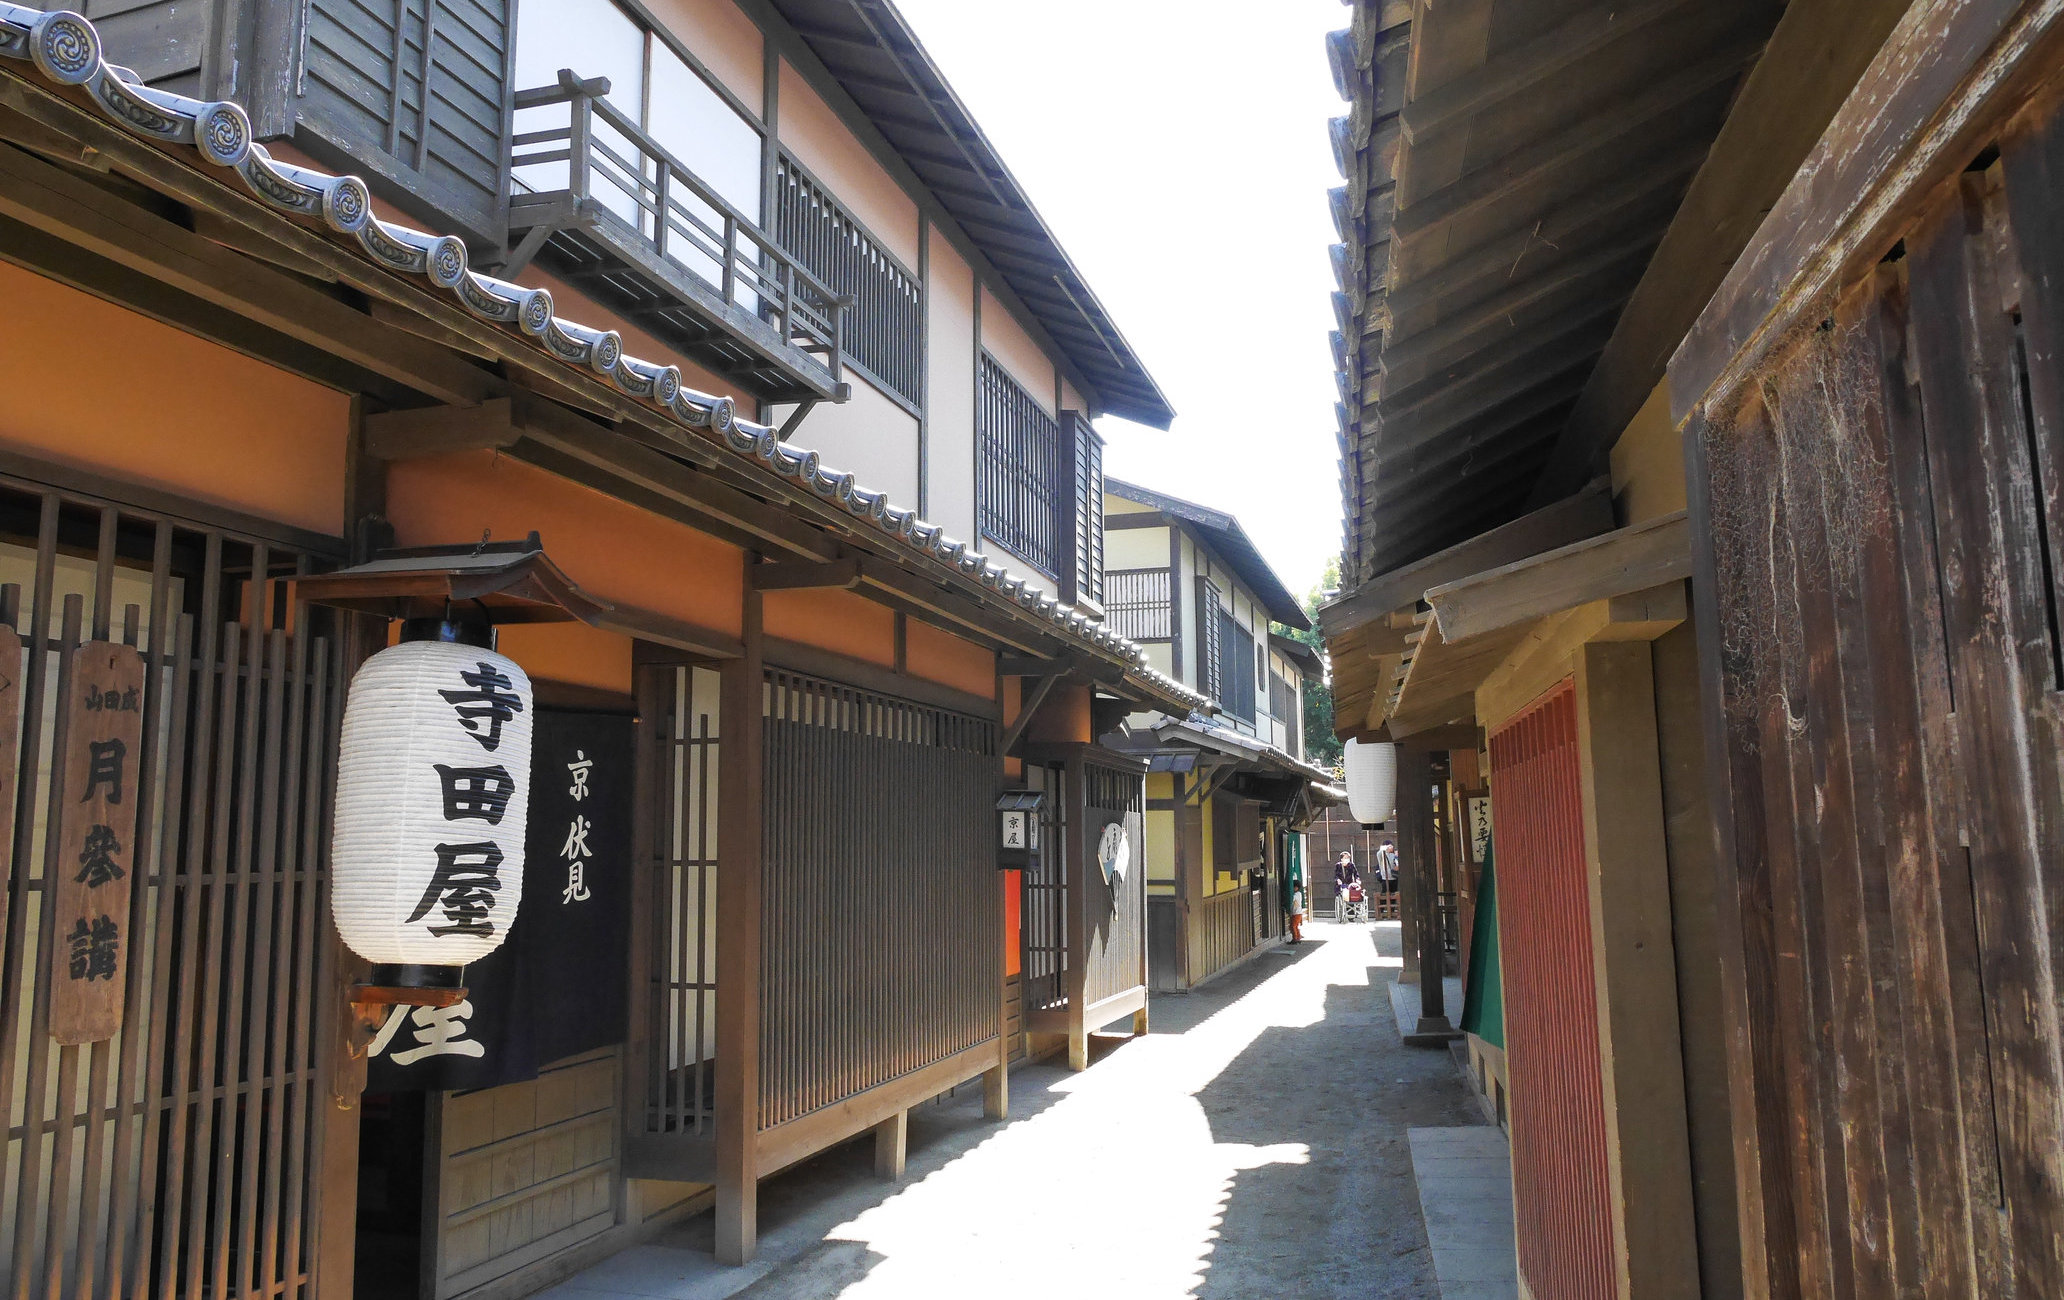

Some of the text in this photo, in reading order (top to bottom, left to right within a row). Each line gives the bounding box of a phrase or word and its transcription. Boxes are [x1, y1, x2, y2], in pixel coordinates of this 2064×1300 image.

[404, 662, 523, 938] 寺田屋
[1007, 816, 1020, 845] 京屋
